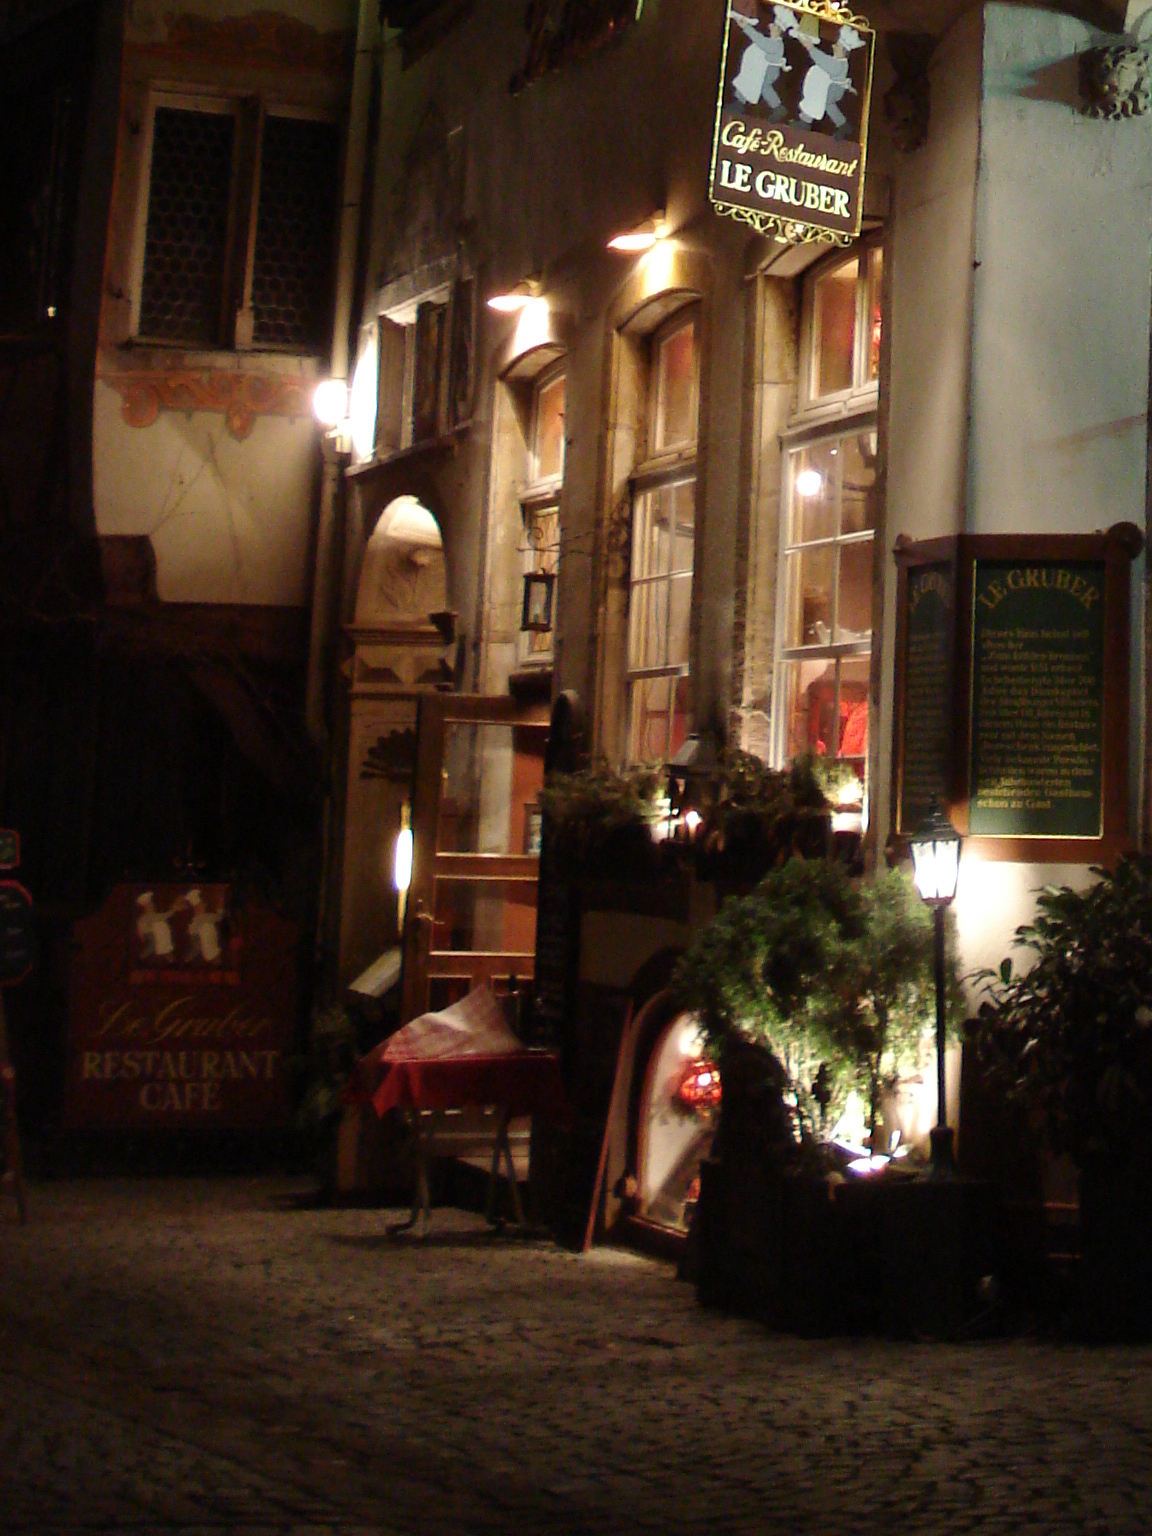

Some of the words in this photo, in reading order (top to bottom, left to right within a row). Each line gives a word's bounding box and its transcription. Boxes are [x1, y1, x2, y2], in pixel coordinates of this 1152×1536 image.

[720, 120, 858, 177] Café-Restaurant
[719, 159, 753, 194] LE
[755, 170, 851, 219] GRUBER
[978, 580, 1008, 610] LE
[1006, 567, 1101, 611] GRUBER
[82, 1050, 280, 1080] RESTAURANT
